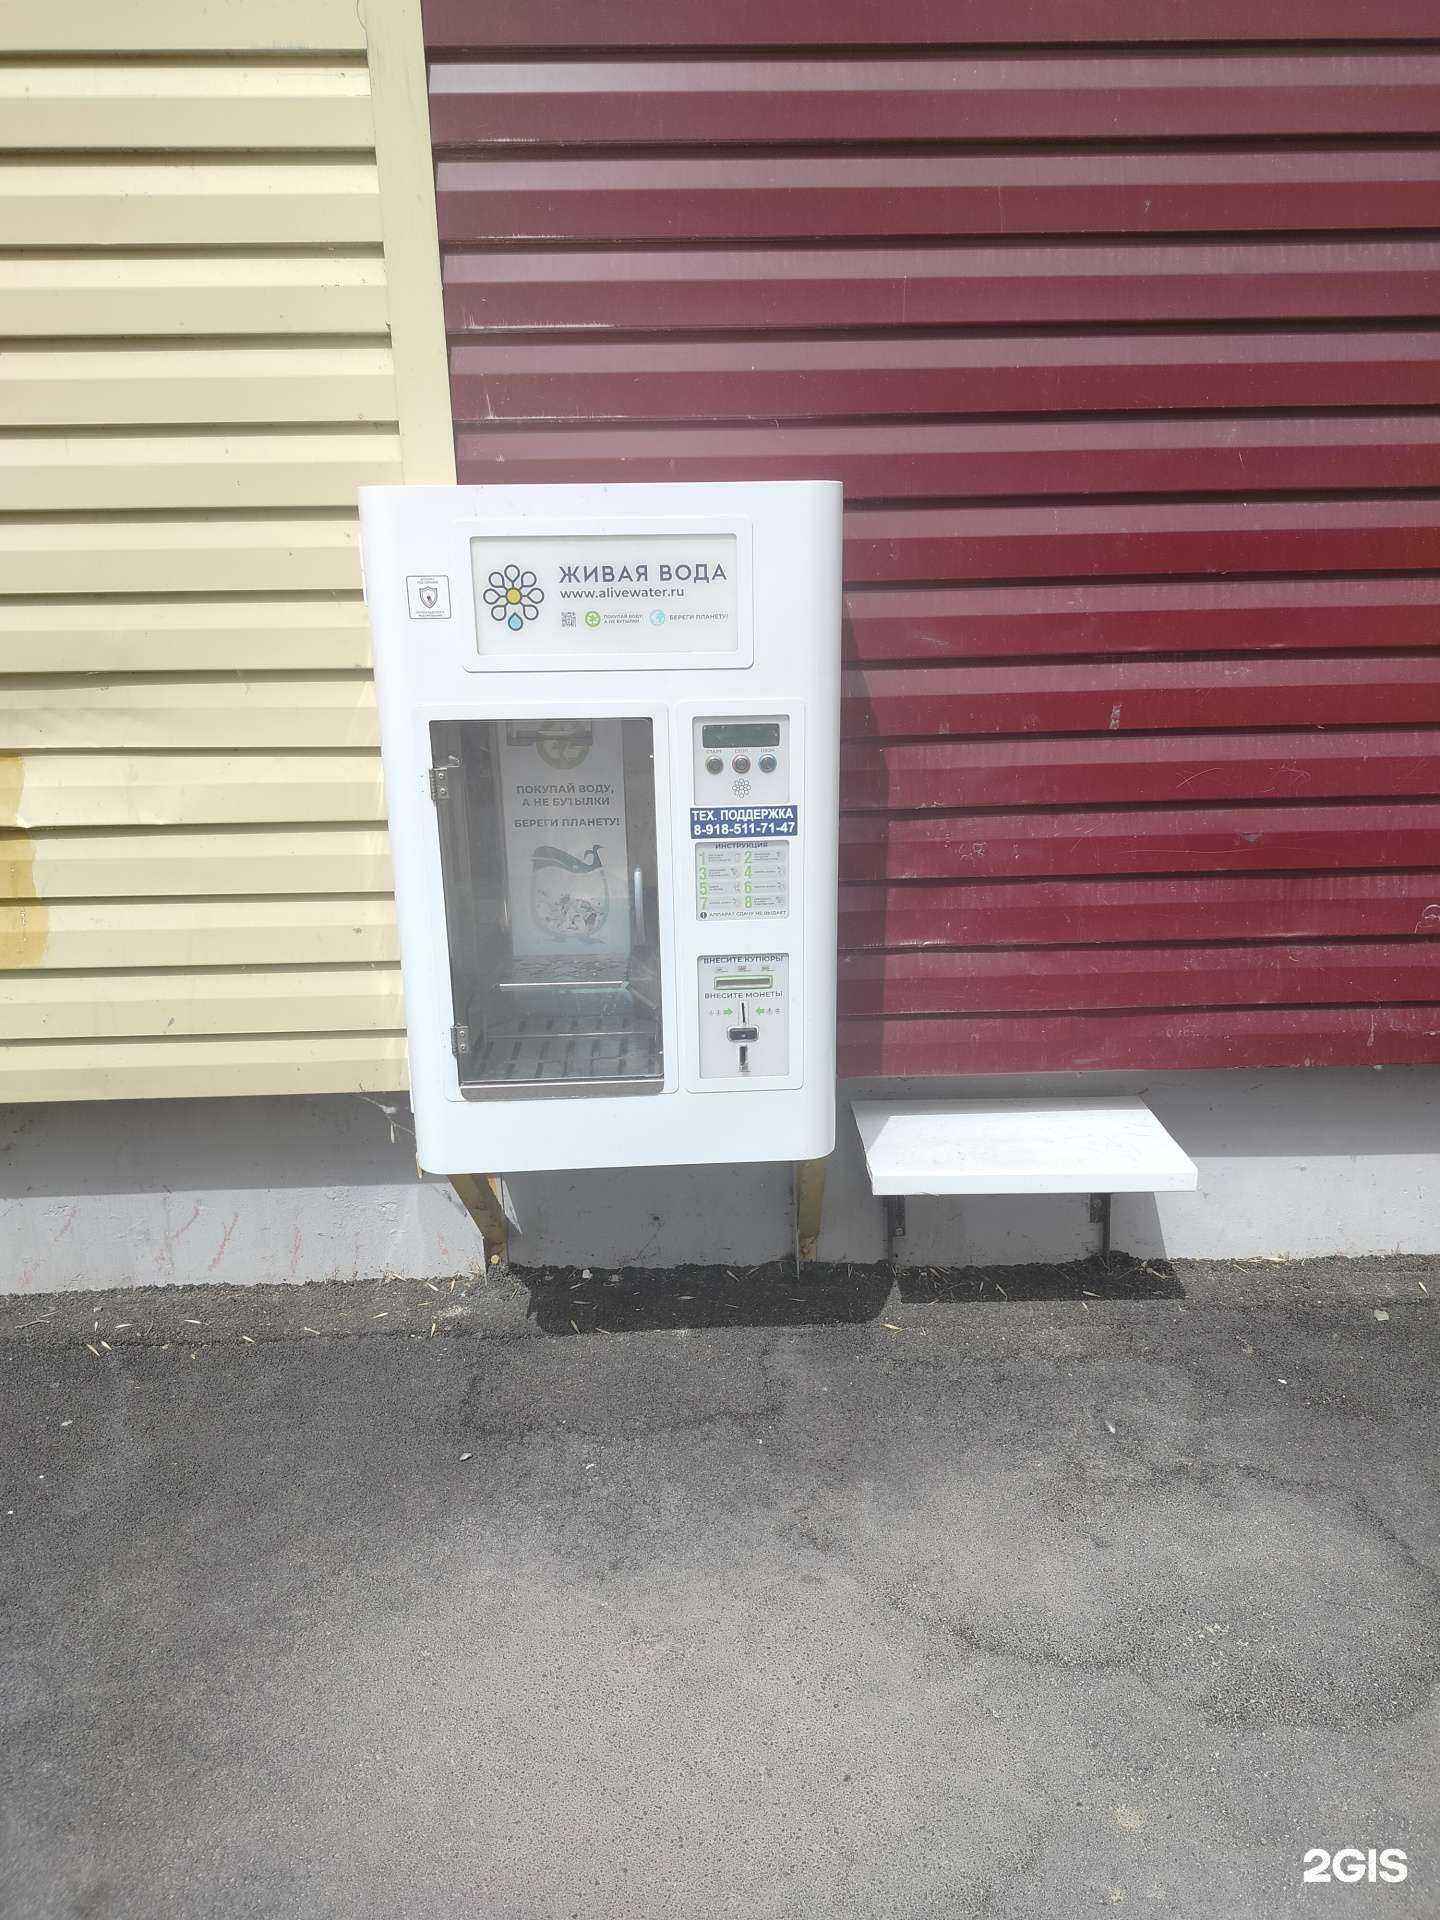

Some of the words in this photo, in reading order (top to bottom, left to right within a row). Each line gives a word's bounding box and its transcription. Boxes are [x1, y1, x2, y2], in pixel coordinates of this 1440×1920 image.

[558, 565, 649, 584] ЖИВАЯ
[659, 563, 728, 584] ВОДА
[560, 586, 685, 600] www.alivewater.ru
[695, 613, 729, 621] ПЛАНЕТУ!
[516, 783, 576, 794] ПОКУПАЙ
[578, 784, 614, 794] ВОДУ,
[522, 798, 530, 807] А
[534, 798, 549, 807] НЕ
[552, 797, 610, 807] БУТЫЛКИ
[691, 810, 718, 821] ТЕХ.
[720, 807, 794, 822] ПОДДЕРЖКА
[514, 819, 559, 828] БЕРЕГИ
[561, 817, 620, 827] ПЛАНЕТУ!
[693, 822, 795, 836] 8-918-511-71-47
[744, 850, 752, 864] 2
[699, 866, 707, 880] 3
[744, 865, 752, 877] 4
[699, 882, 707, 896] 5
[744, 881, 752, 893] 6
[699, 897, 708, 910] 7
[744, 895, 752, 908] 8
[703, 956, 743, 964] ВНЕСИТЕ
[744, 955, 783, 963] КУПЮРЫ
